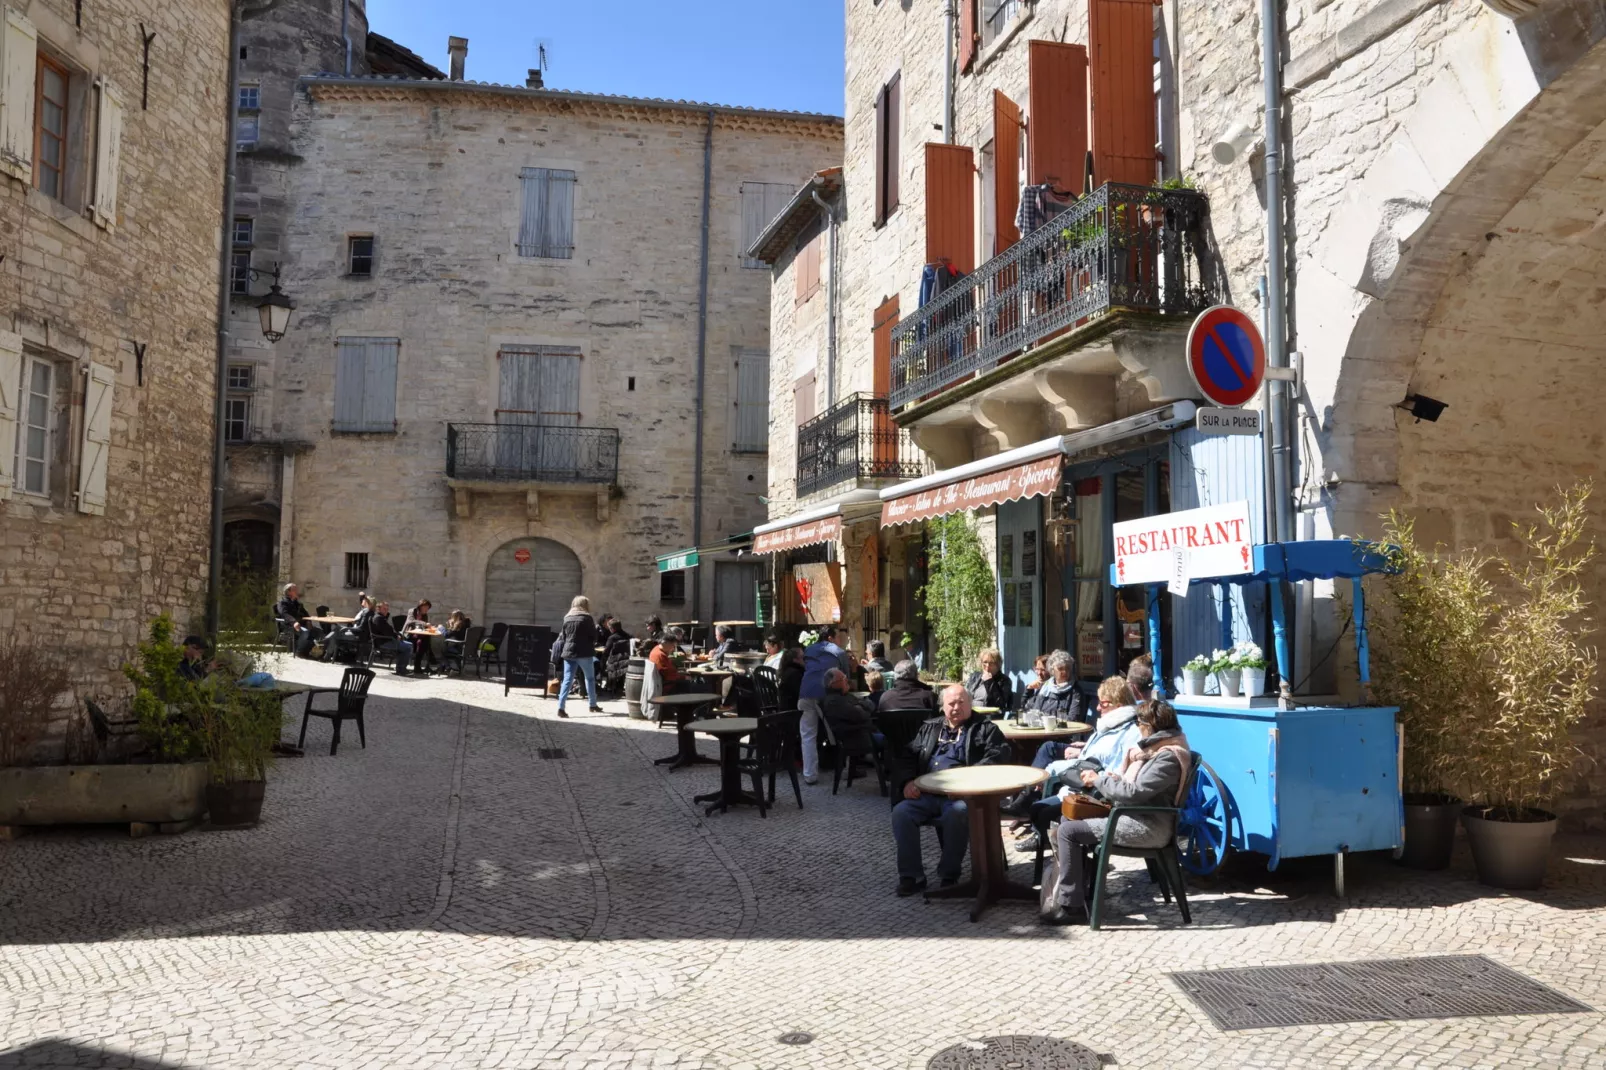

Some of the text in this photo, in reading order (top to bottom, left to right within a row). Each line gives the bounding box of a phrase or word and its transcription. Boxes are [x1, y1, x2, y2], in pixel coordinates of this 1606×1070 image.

[1202, 415, 1257, 428] SUR LA PLACE
[912, 492, 931, 512] Salon
[932, 491, 942, 507] de
[963, 475, 1011, 499] Restaurant
[1116, 518, 1244, 557] RESTAURANT
